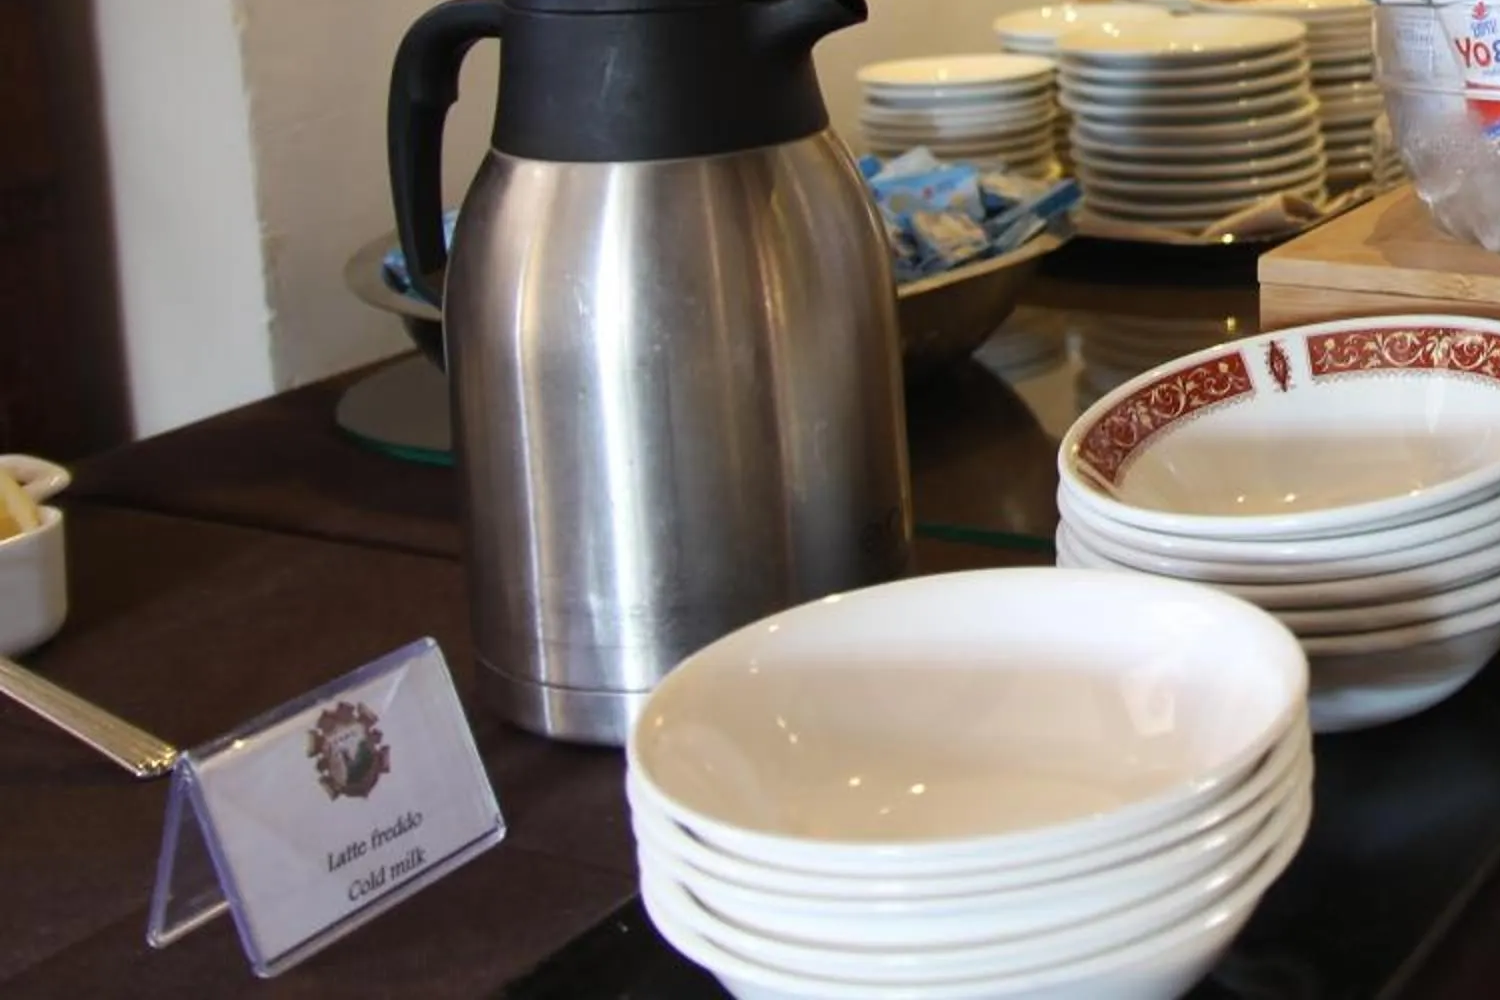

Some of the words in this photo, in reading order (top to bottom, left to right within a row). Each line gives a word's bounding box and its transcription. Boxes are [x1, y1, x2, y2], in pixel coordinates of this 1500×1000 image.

[328, 840, 366, 872] Latte
[371, 811, 423, 850] freddo
[348, 865, 385, 901] Cold
[390, 846, 427, 880] milk
